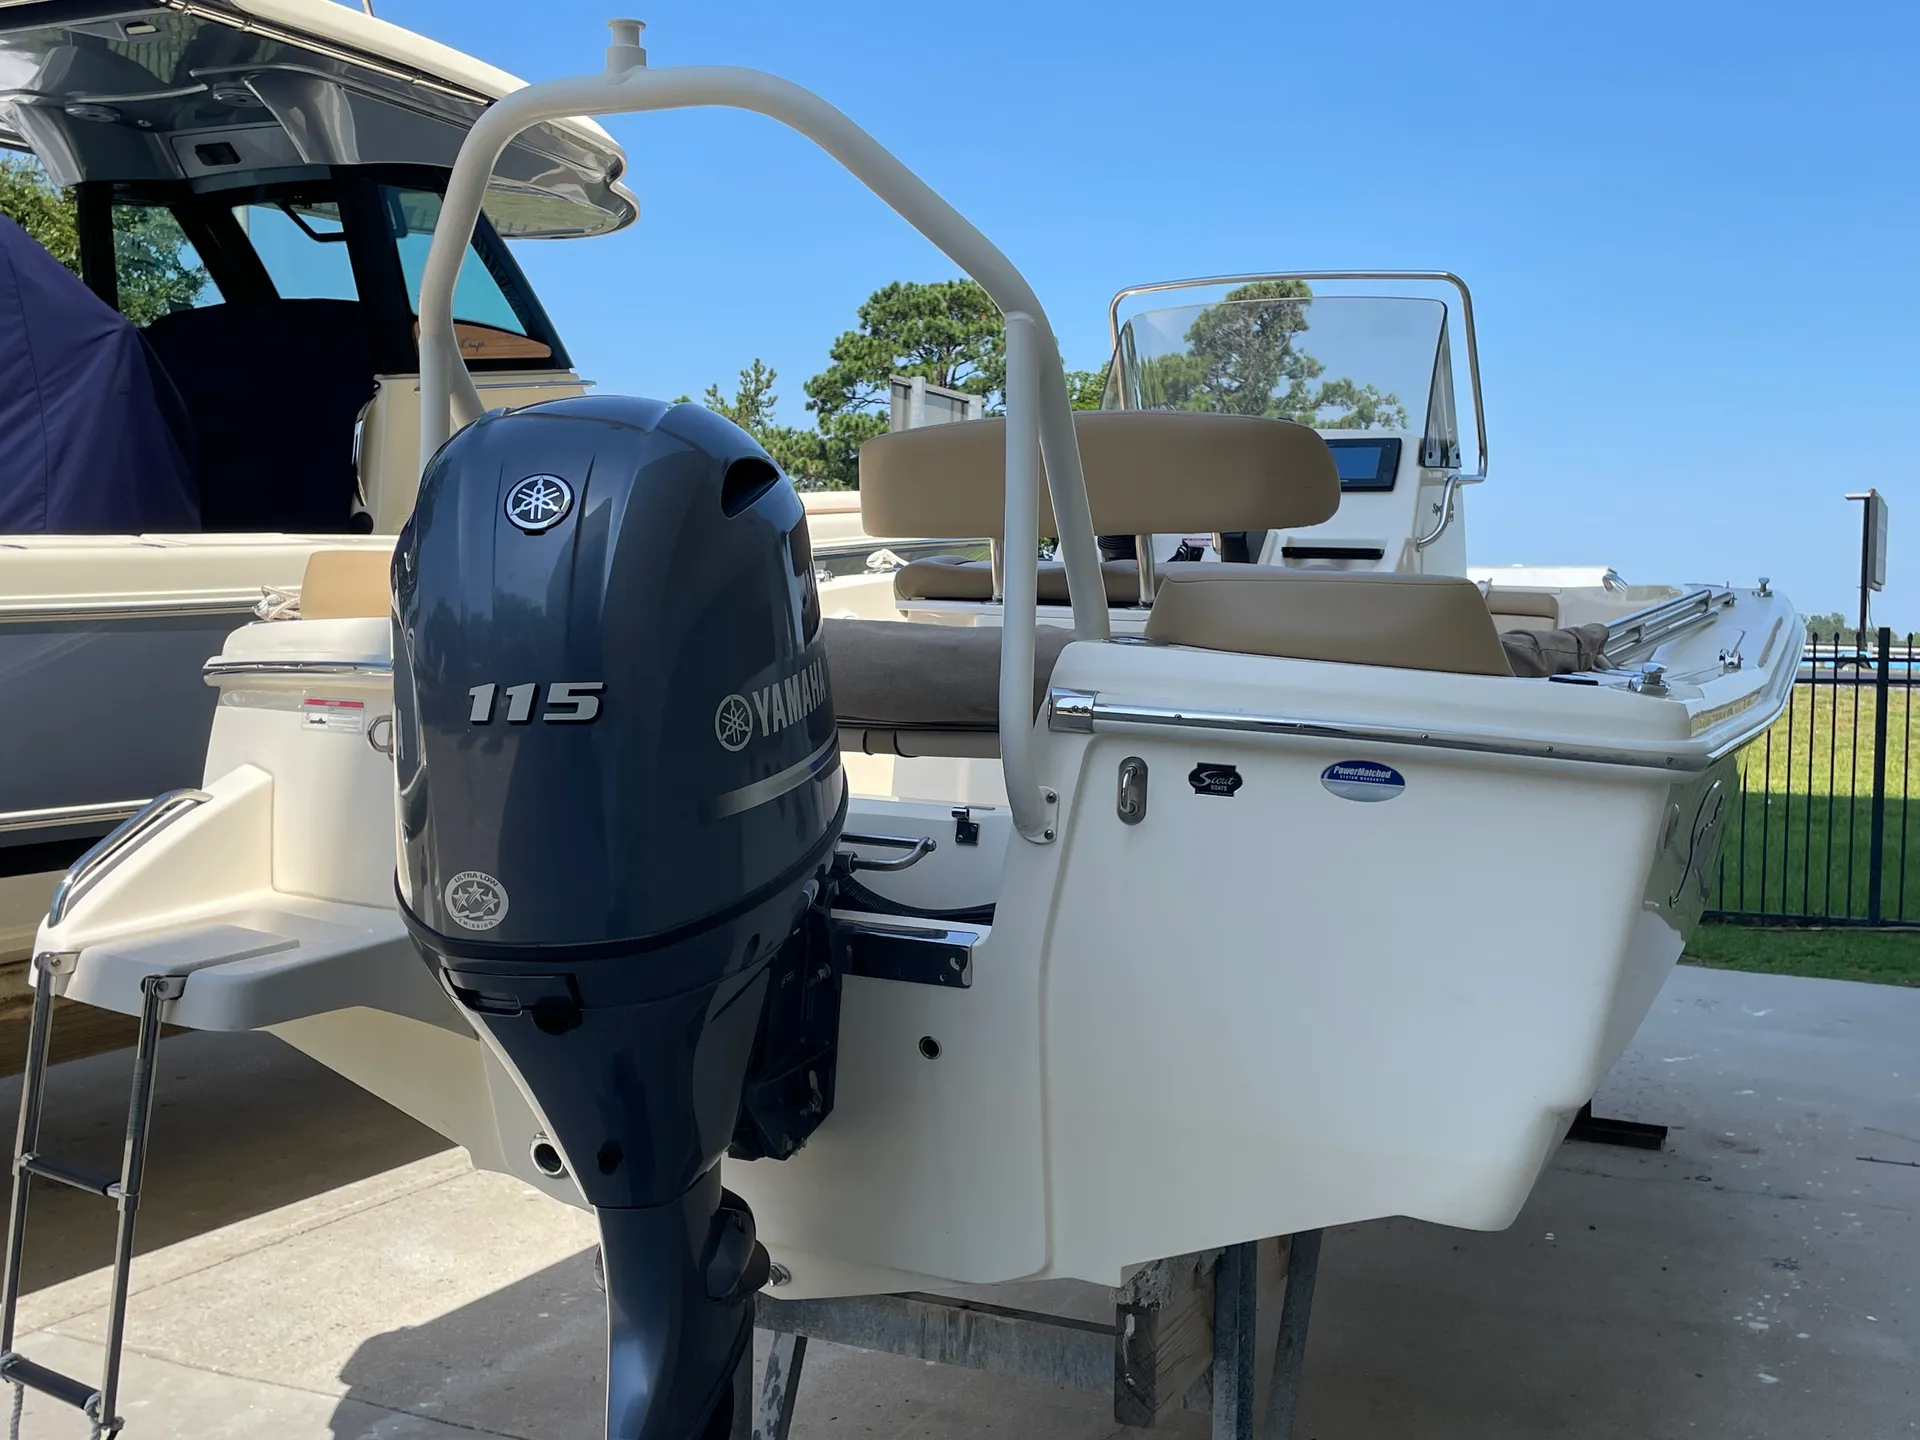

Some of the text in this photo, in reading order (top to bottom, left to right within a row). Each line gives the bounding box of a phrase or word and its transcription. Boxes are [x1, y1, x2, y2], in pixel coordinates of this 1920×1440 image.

[469, 682, 604, 721] 115
[752, 657, 827, 737] YAMAHA
[1190, 770, 1238, 786] Scout
[1333, 765, 1393, 779] PowerMatched
[1210, 784, 1228, 792] BOATS
[454, 872, 499, 887] ULTRA LOW
[458, 918, 494, 929] EMISSION
